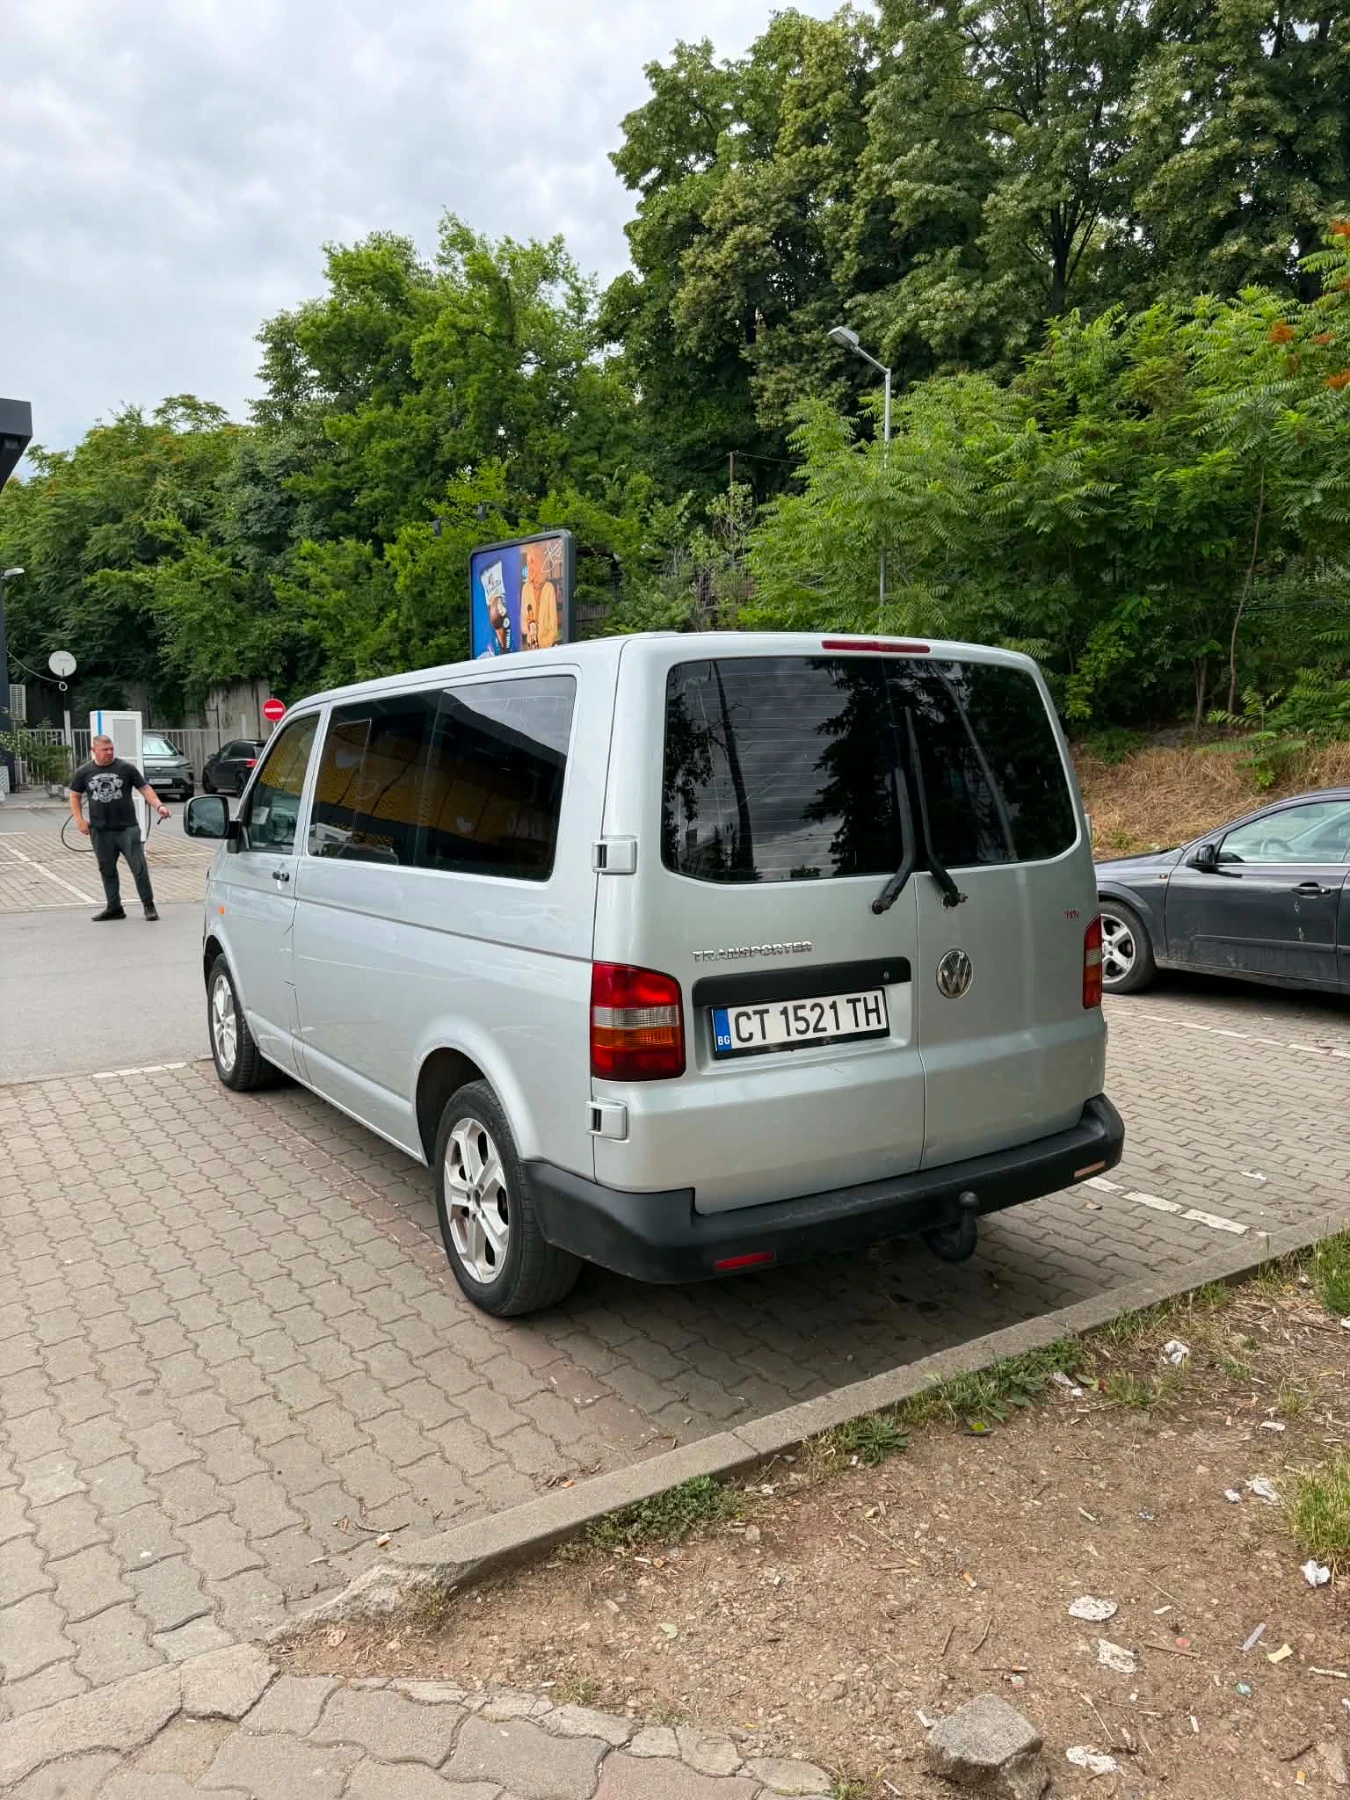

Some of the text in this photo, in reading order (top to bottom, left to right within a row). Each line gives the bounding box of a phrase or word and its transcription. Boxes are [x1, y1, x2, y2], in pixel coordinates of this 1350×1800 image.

[692, 940, 813, 962] TRANSPORTER
[734, 995, 882, 1043] CT 1521 TH
[717, 1035, 731, 1046] BG
